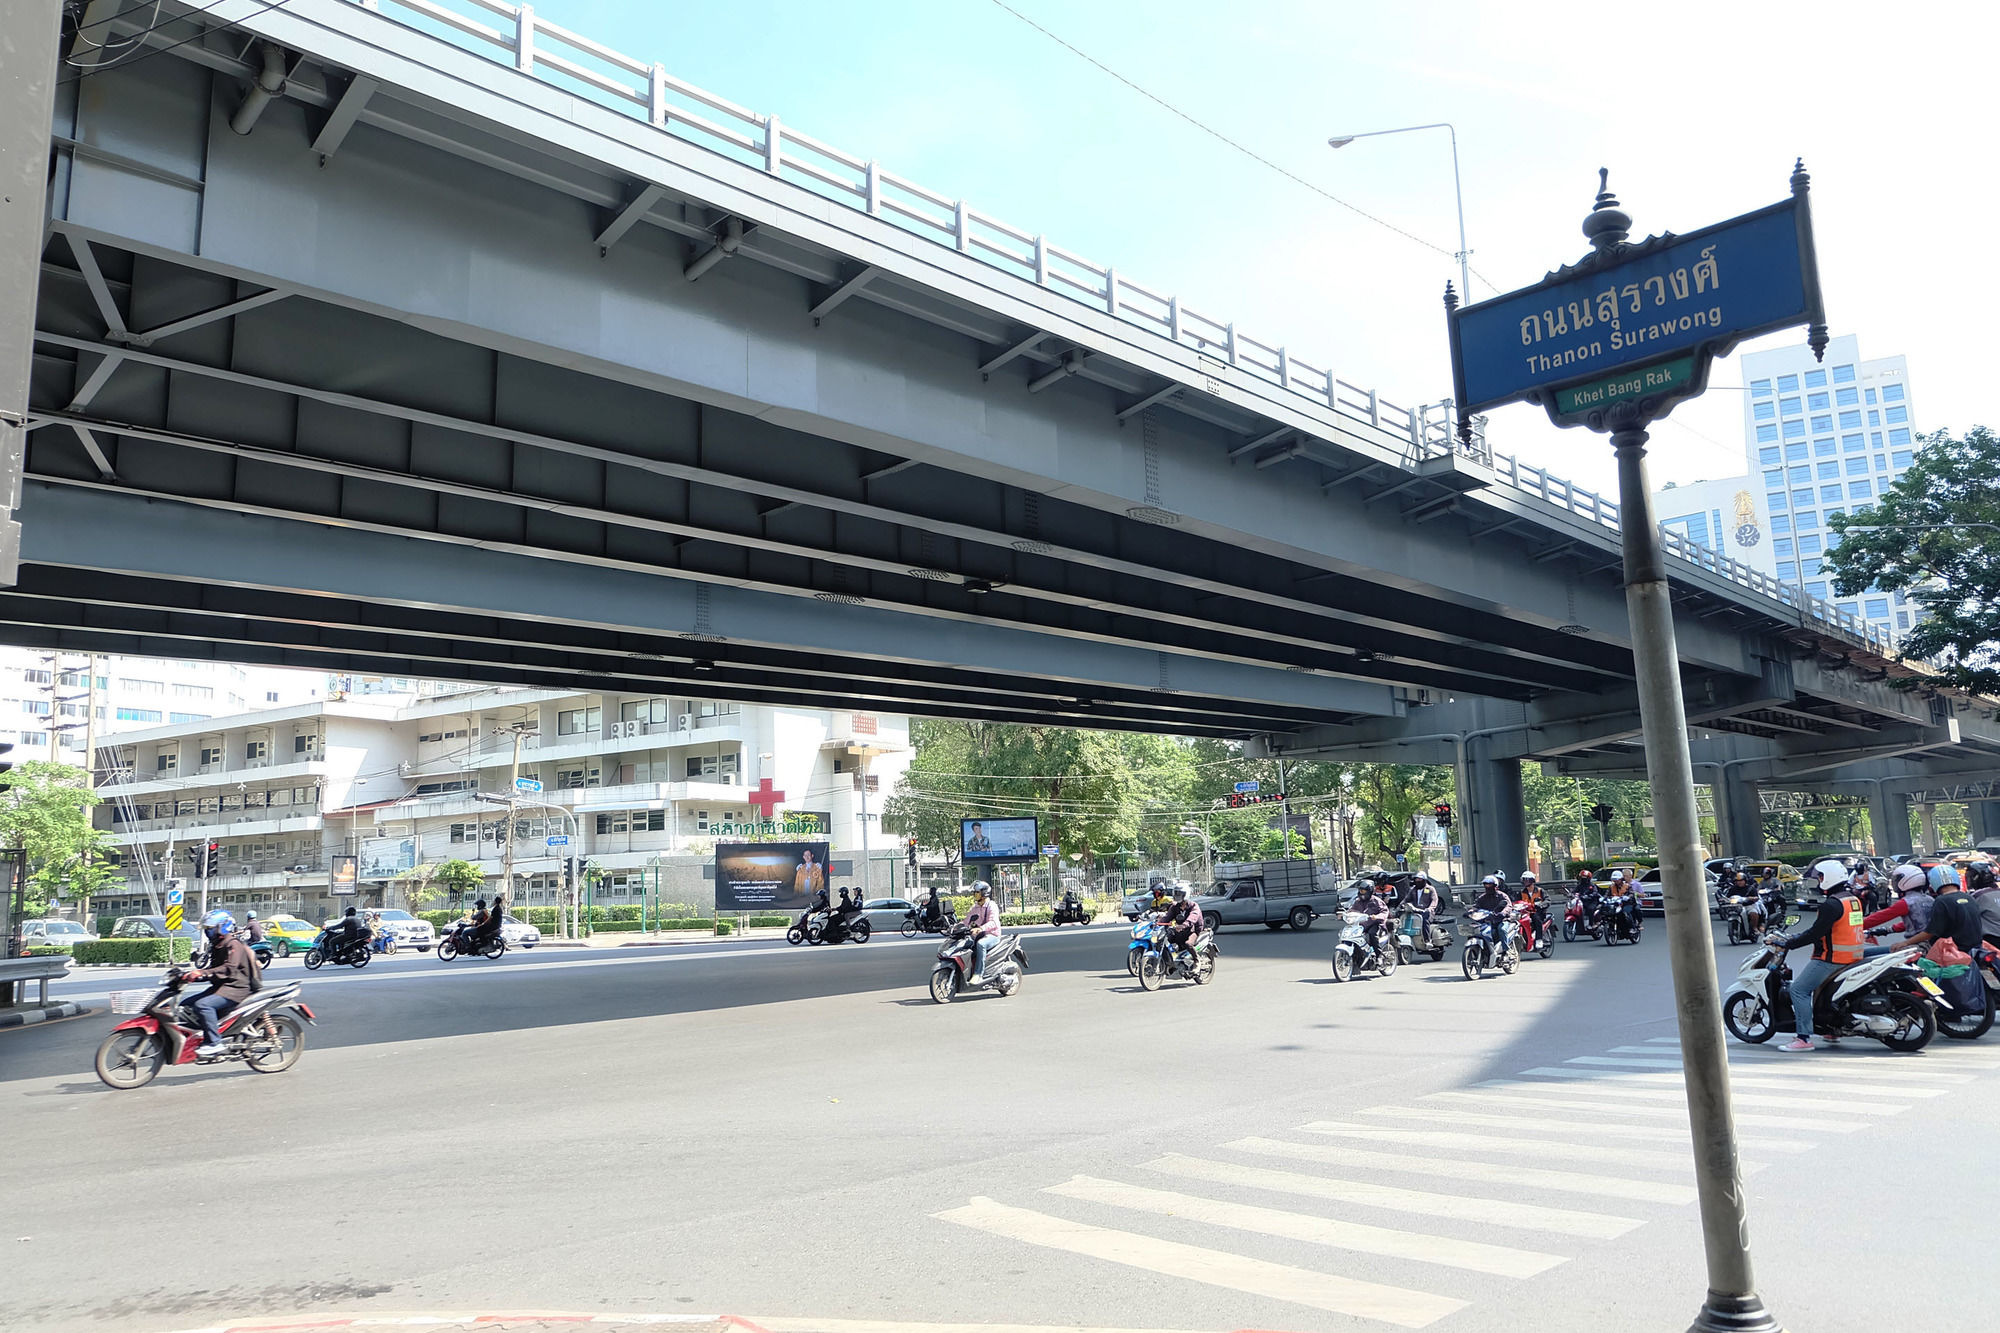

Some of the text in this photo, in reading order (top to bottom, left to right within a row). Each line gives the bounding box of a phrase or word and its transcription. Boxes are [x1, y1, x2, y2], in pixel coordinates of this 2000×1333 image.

[1520, 246, 1719, 345] ถนนสุรวงศ์
[1526, 306, 1722, 374] Thanon Surawong
[1573, 368, 1673, 406] Khet Bang Rak
